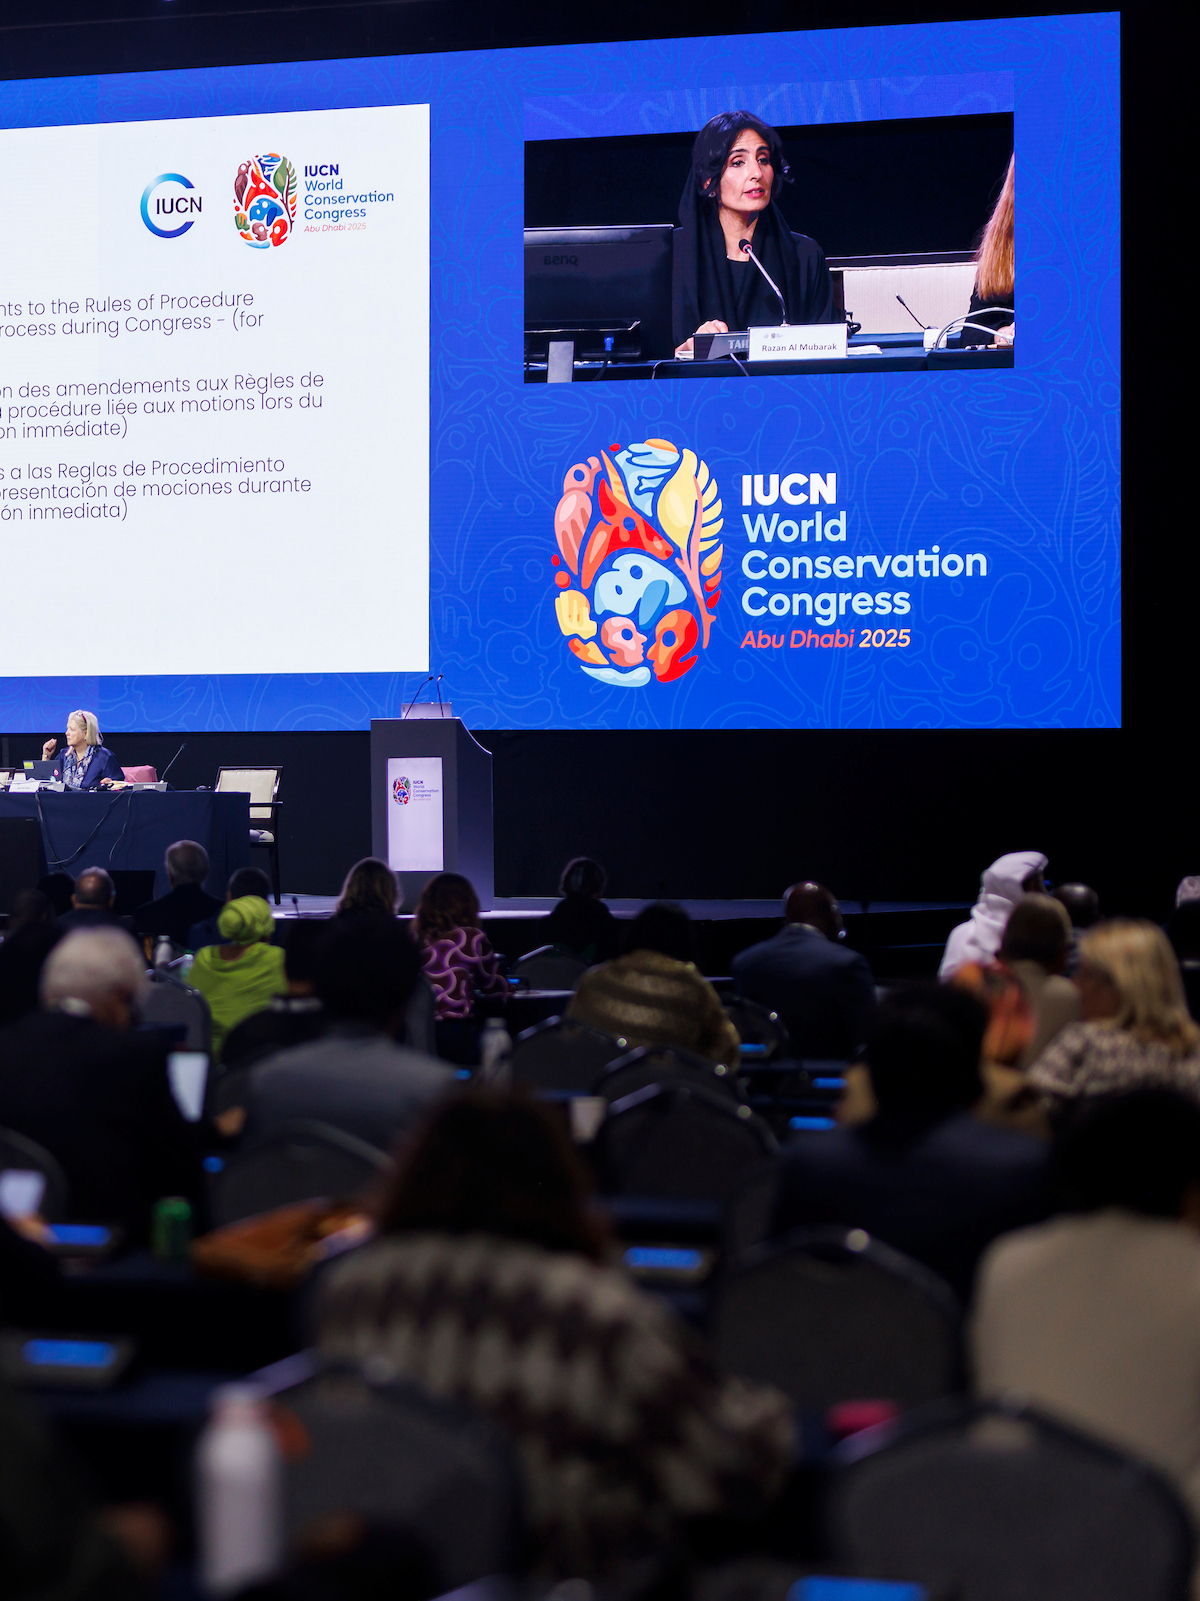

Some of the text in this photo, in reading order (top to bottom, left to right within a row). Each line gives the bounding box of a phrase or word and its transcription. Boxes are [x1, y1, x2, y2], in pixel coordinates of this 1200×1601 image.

[305, 164, 339, 177] IUCN
[305, 178, 343, 191] World
[156, 197, 202, 215] IUCN
[305, 191, 394, 205] Conservation
[305, 208, 366, 222] Congress
[322, 223, 346, 232] Dhabi
[348, 222, 366, 230] 2025
[28, 301, 45, 315] to
[51, 299, 79, 314] the
[85, 296, 132, 313] Rules
[137, 294, 154, 310] of
[160, 291, 254, 309] Procedure
[62, 319, 119, 338] during
[125, 315, 211, 336] Congress
[232, 308, 264, 331] (for
[761, 342, 837, 352] Razan Al Mubarak
[18, 382, 50, 398] des
[56, 377, 190, 397] amendements
[196, 376, 228, 391] aux
[235, 373, 294, 394] Règles
[300, 371, 324, 387] de
[8, 400, 101, 423] procédure
[108, 399, 137, 415] liée
[143, 399, 175, 413] aux
[181, 395, 255, 413] motions
[261, 393, 292, 410] lors
[299, 392, 323, 408] du
[23, 415, 127, 439] immédiate)
[10, 468, 21, 480] a
[28, 464, 52, 479] las
[58, 462, 117, 483] Reglas
[123, 460, 146, 476] de
[152, 457, 285, 476] Procedimiento
[114, 481, 136, 497] de
[143, 479, 232, 496] mociones
[238, 476, 311, 493] durante
[742, 473, 836, 506] IUCN
[29, 498, 127, 521] inmediata)
[742, 511, 846, 543] World
[742, 545, 987, 579] Conservation
[742, 586, 911, 626] Congress
[740, 629, 911, 649] Abu Dhabi 2025
